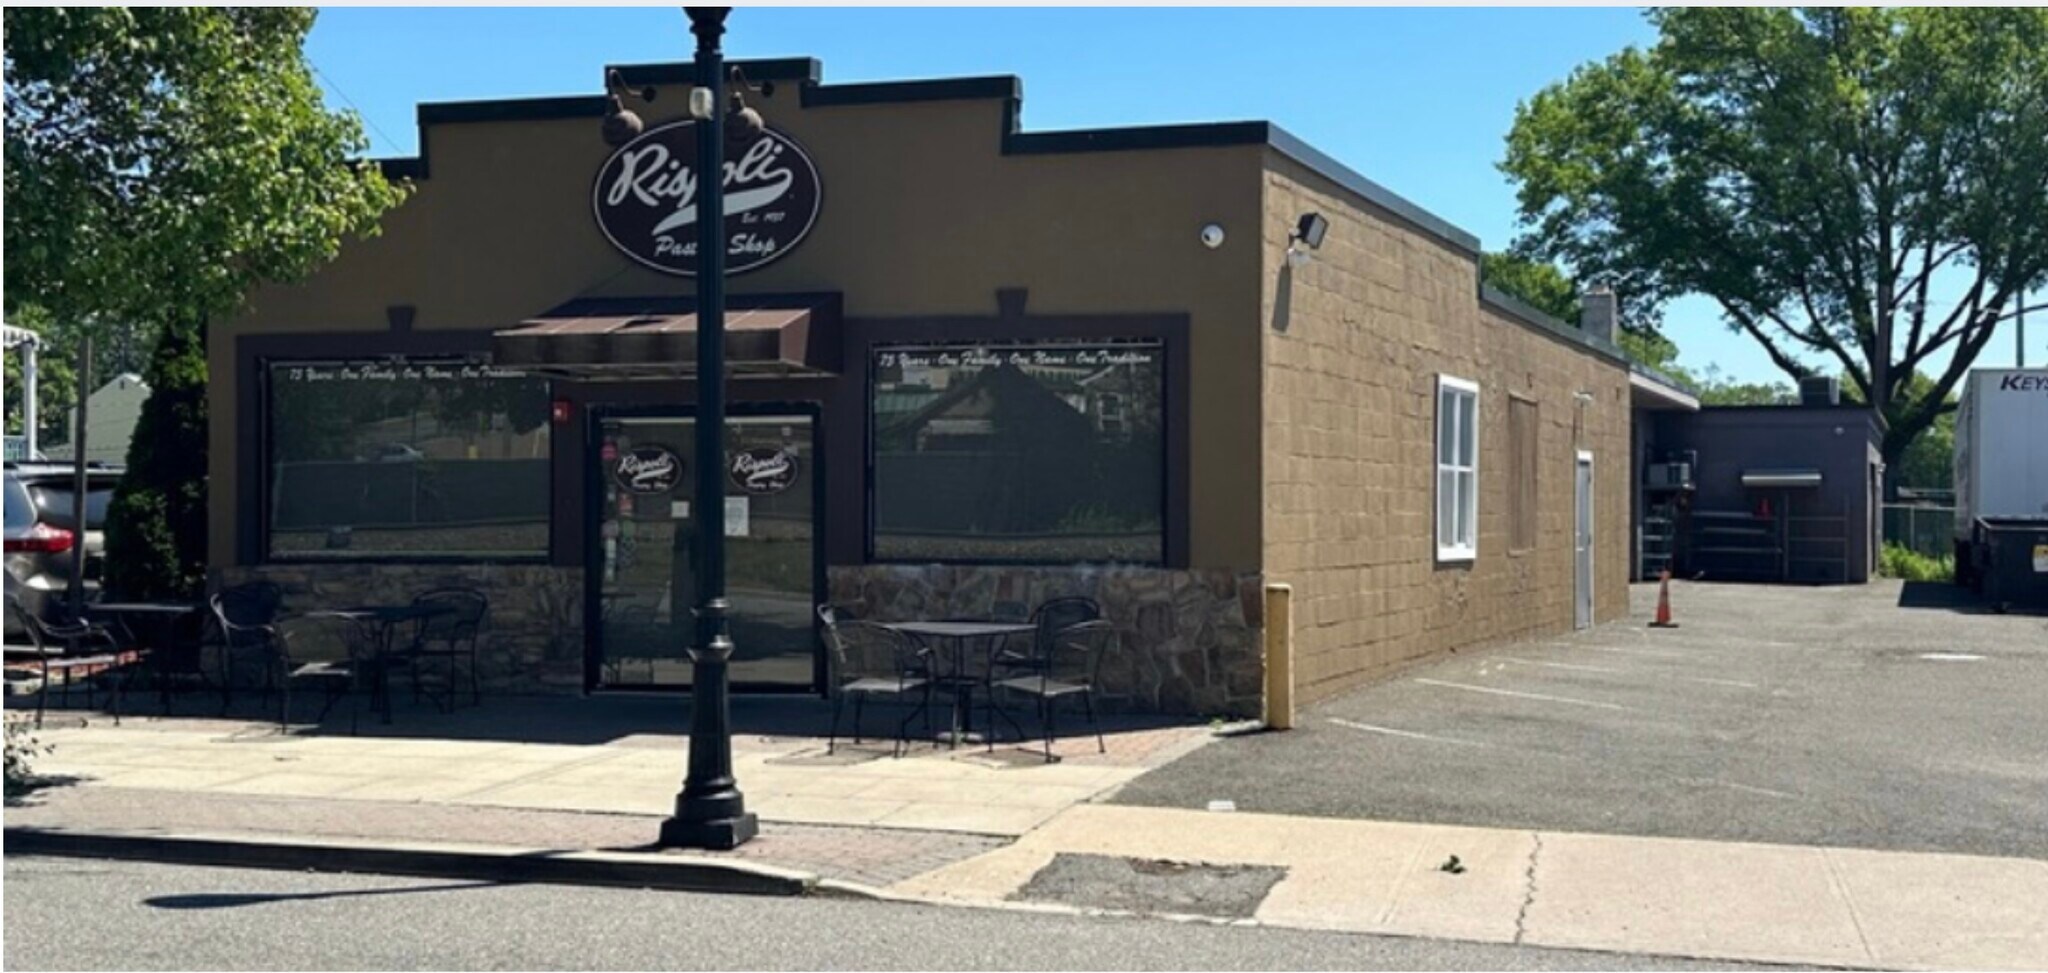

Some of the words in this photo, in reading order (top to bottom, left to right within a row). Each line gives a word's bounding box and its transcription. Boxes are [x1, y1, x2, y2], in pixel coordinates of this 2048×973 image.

[654, 236, 698, 256] Past
[728, 233, 776, 256] Shop
[879, 353, 895, 367] 75
[898, 353, 930, 368] Years
[938, 353, 959, 366] One
[960, 350, 1002, 368] Family
[1009, 352, 1030, 365] One
[1032, 350, 1066, 365] Name
[1076, 351, 1097, 364] One
[1097, 350, 1152, 364] Tradition
[289, 368, 303, 380] 75
[305, 367, 334, 382] Years
[340, 367, 359, 380] One
[360, 365, 396, 382] Family
[403, 366, 421, 379] One
[425, 365, 453, 379] Name
[461, 366, 479, 378] One
